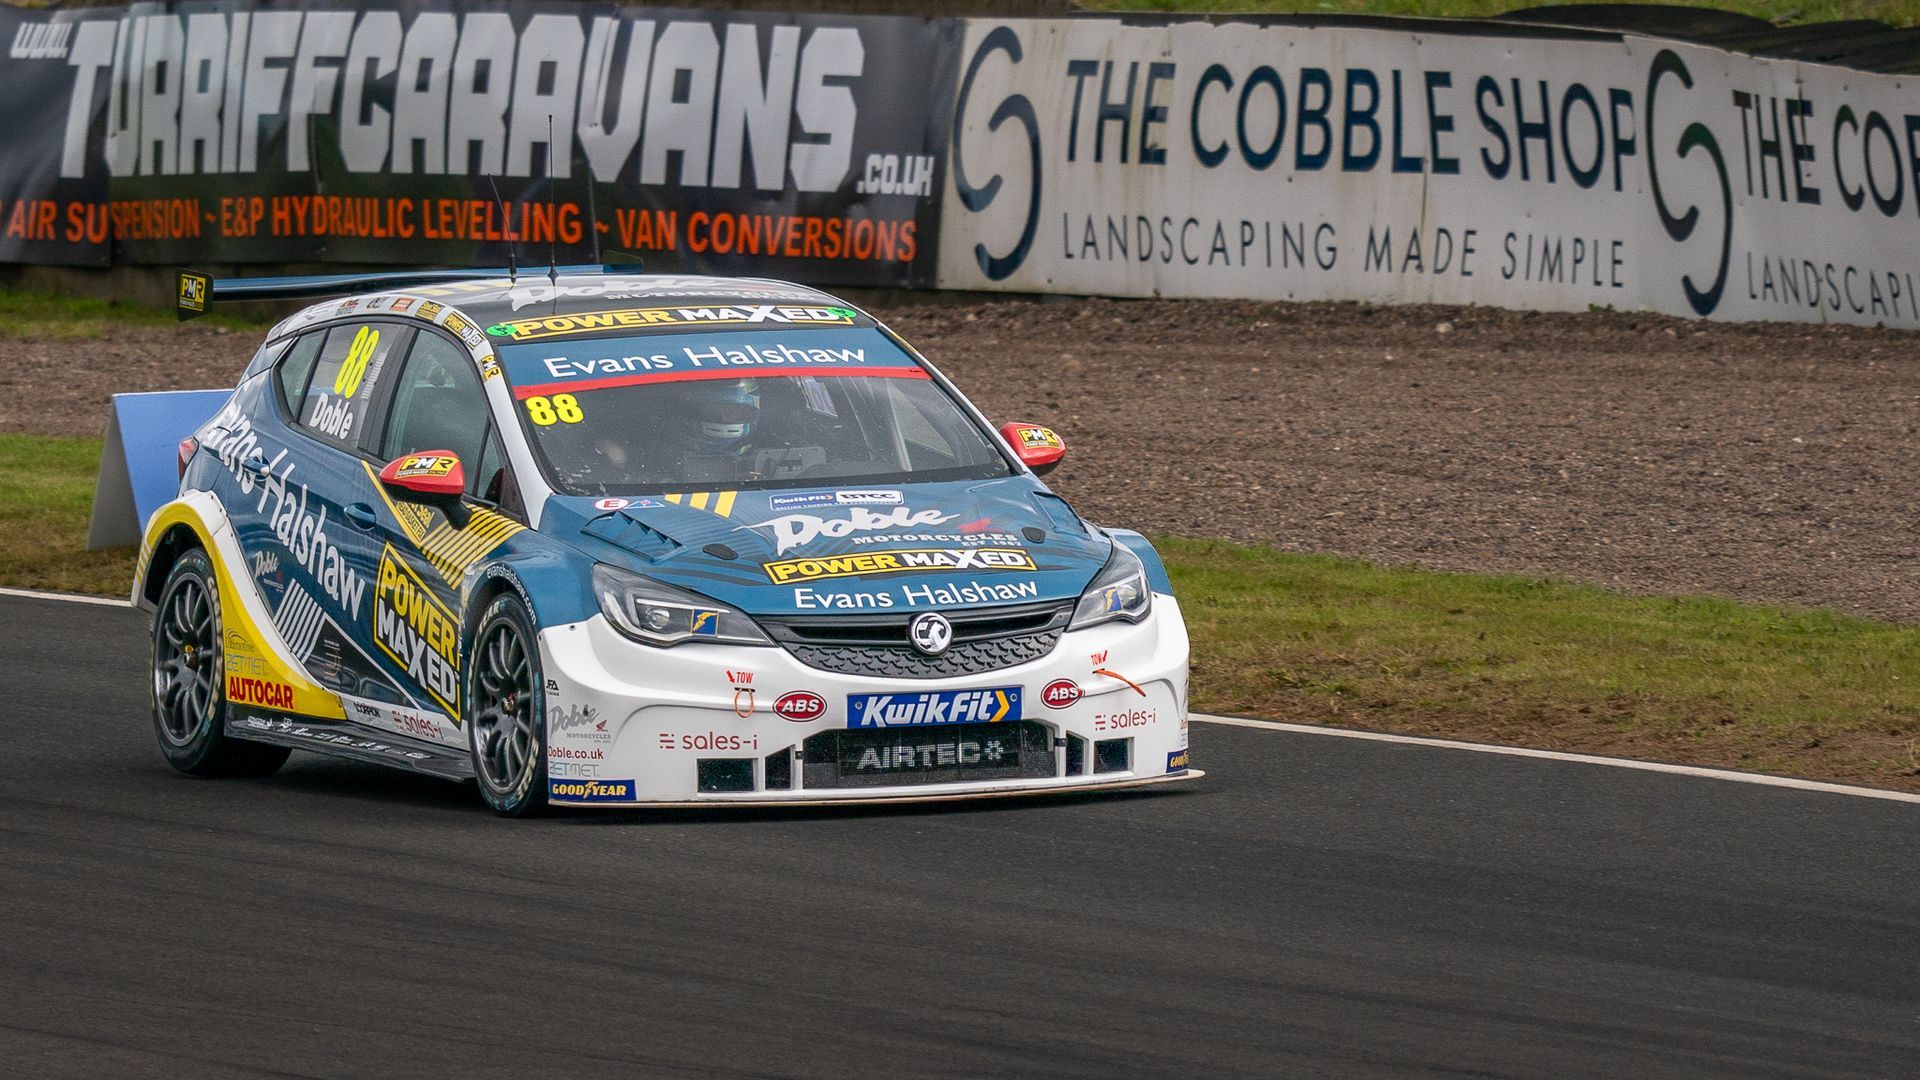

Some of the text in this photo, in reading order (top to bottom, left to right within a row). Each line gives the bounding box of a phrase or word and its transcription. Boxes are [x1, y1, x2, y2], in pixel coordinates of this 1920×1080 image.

[1067, 59, 1636, 192] THE COBBLE SHOP
[1732, 89, 1821, 205] THE
[7, 196, 918, 262] AIR SUSPENSION E&P HYDRAULIC LEVELLING VAN CONVERSIONS
[1063, 211, 1624, 288] LANDSCAPING MADE SIMPLE
[181, 277, 206, 301] PMR
[515, 309, 678, 336] POWER
[677, 305, 840, 323] MAXED
[334, 325, 380, 399] 88
[543, 344, 866, 379] Evans Halshaw
[309, 392, 355, 440] Doble
[525, 393, 584, 426] 88
[400, 457, 455, 471] PMR
[257, 448, 365, 620] Halshaw
[731, 506, 960, 556] Doble
[852, 533, 1018, 545] MOTORCYCLES
[772, 549, 1028, 580] POWER MAXED
[794, 580, 1038, 609] Evans Halshaw
[379, 556, 456, 668] POWER
[378, 597, 456, 705] MAXED
[229, 676, 294, 710] AUTOCAR
[736, 672, 755, 685] TOW
[1048, 686, 1080, 701] ABS
[780, 698, 820, 713] ABS
[1110, 708, 1156, 729] sales-i
[682, 731, 758, 750] sales-i
[856, 741, 981, 770] AIRTEC
[552, 783, 627, 798] GOODYEAR
